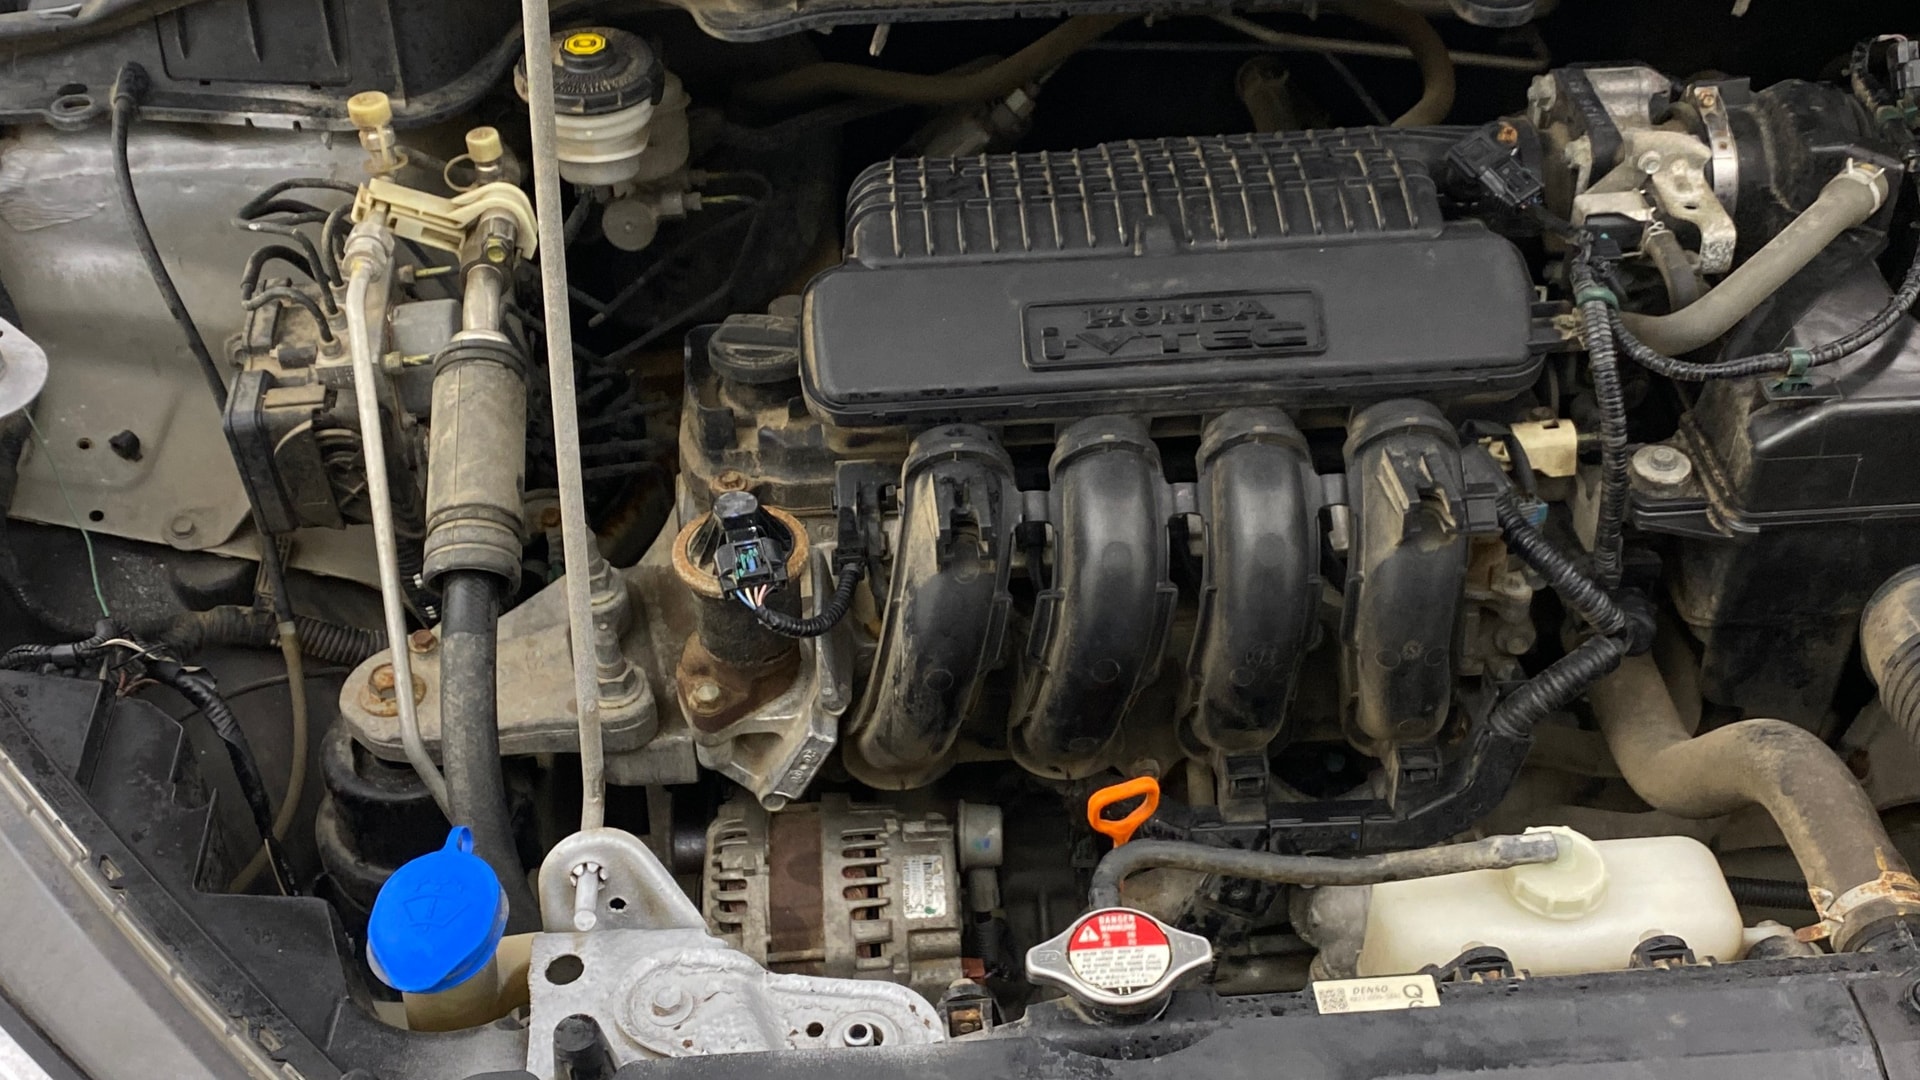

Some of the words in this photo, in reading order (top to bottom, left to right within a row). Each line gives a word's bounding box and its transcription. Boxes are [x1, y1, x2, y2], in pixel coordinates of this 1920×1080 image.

[1084, 301, 1275, 328] HONDA
[1099, 915, 1135, 924] DANGER
[1353, 985, 1388, 995] DENSO
